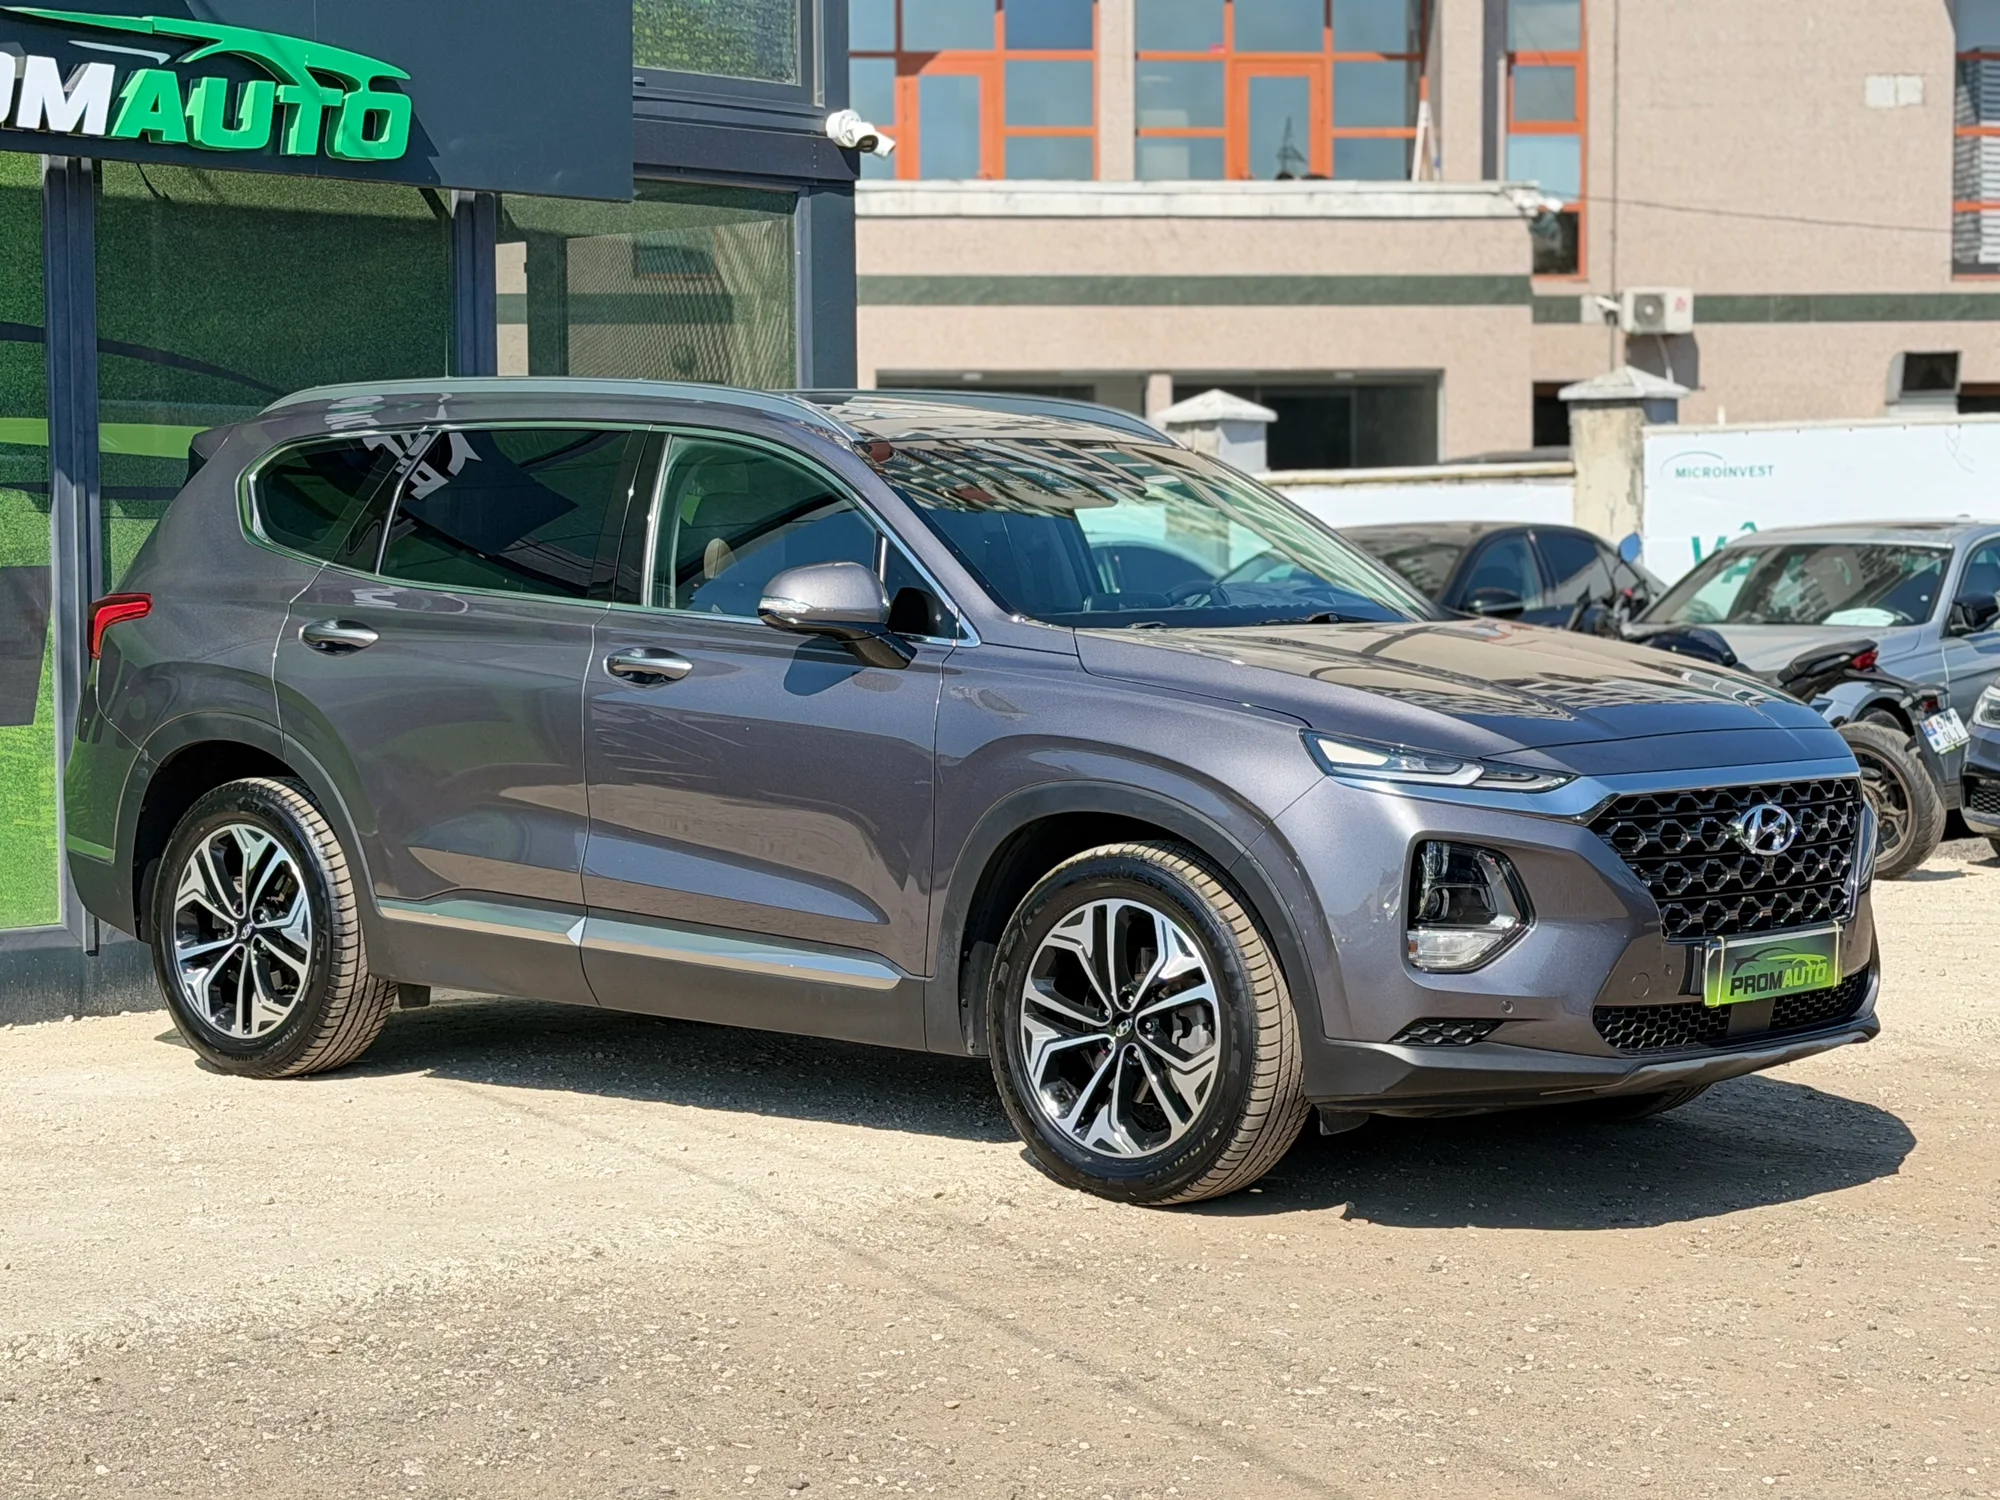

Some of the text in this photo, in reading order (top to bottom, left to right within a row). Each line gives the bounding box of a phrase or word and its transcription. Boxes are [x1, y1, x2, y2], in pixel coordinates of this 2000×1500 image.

[0, 51, 412, 161] MAUTO
[1674, 463, 1775, 479] MICROINVEST
[1729, 962, 1828, 997] PROMAUTO
